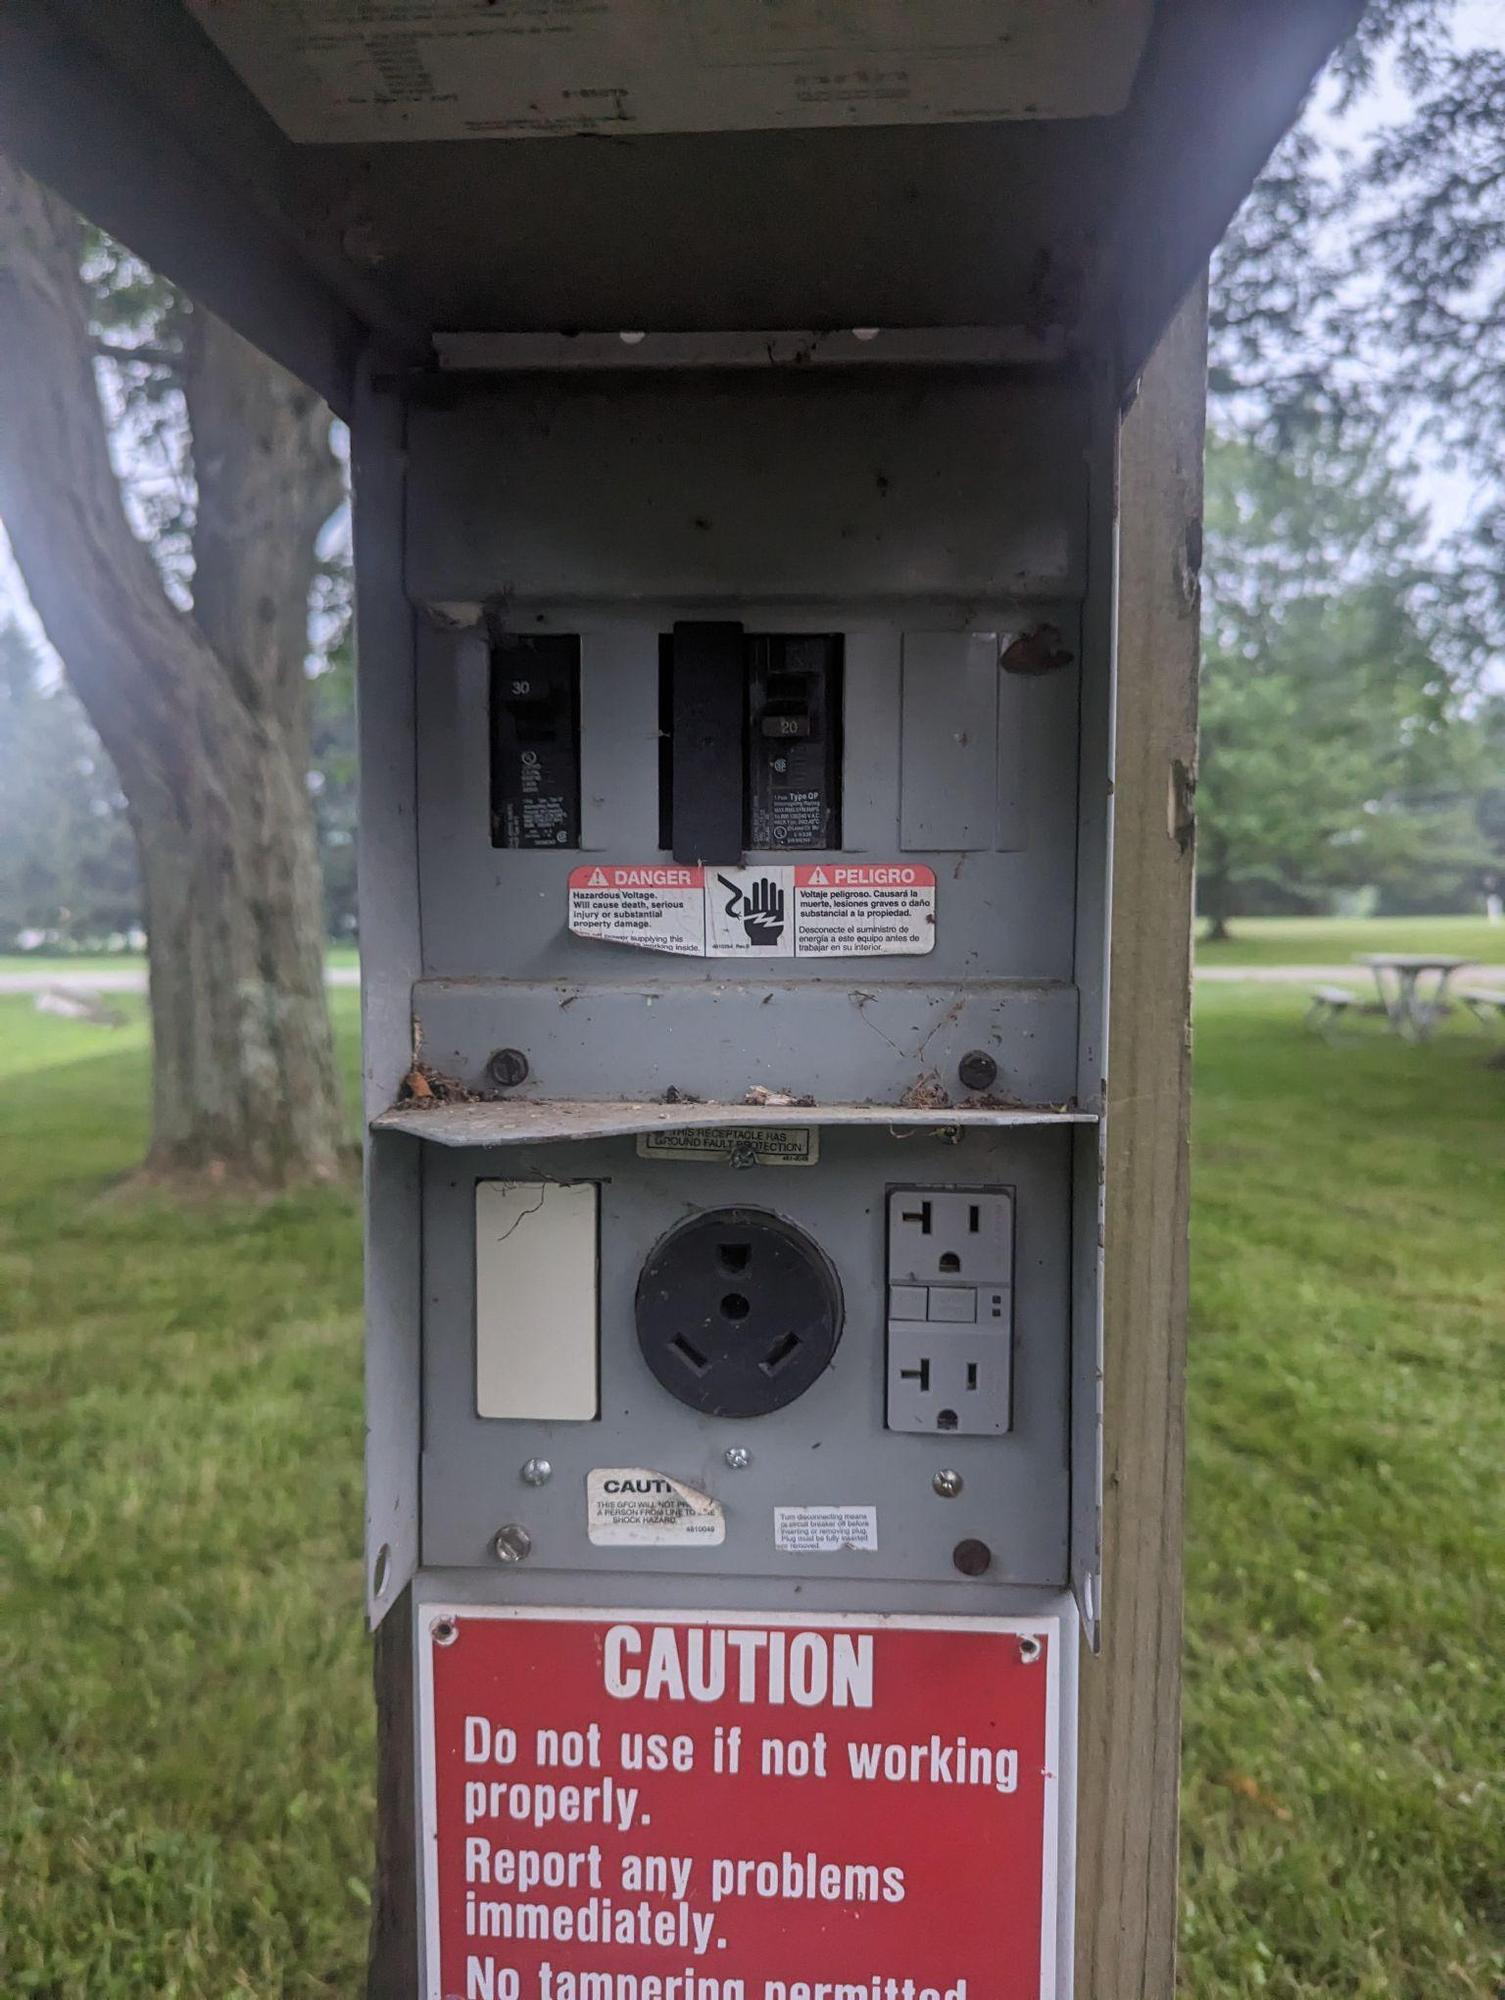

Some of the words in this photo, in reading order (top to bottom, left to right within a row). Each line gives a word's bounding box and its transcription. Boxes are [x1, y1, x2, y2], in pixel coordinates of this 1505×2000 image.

[511, 681, 530, 695] 30
[790, 792, 807, 801] Type
[614, 870, 692, 886] DANGER
[834, 868, 916, 884] PELIGRO
[573, 891, 620, 900] Hazardous
[622, 891, 658, 901] Voltage.
[800, 889, 828, 900] Voltaje
[830, 890, 872, 900] peligroso.
[873, 889, 908, 898] Causará
[910, 890, 918, 898] la
[573, 901, 590, 909] Will
[621, 901, 649, 910] death,
[651, 901, 684, 909] serious
[800, 901, 832, 909] muerte,
[833, 900, 869, 908] lesiones
[870, 901, 899, 910] graves
[908, 899, 931, 908] daño
[573, 910, 599, 920] injury
[601, 911, 611, 919] or
[613, 910, 663, 919] substantial
[800, 909, 848, 918] substancial
[857, 909, 865, 917] la
[867, 909, 912, 919] propiedad.
[573, 920, 611, 929] property
[614, 919, 652, 929] damage.
[799, 926, 846, 935] Desconecte
[847, 926, 855, 935] el
[856, 926, 897, 934] suministro
[898, 926, 909, 934] de
[630, 935, 668, 944] supplying
[670, 934, 684, 943] this
[799, 935, 828, 945] energía
[838, 935, 855, 943] este
[856, 935, 884, 944] equipo
[885, 935, 908, 943] antes
[909, 934, 920, 942] de
[675, 942, 699, 951] inside.
[799, 944, 829, 953] trabajar
[854, 943, 883, 951] interior.
[671, 1127, 695, 1138] THIS
[697, 1128, 764, 1141] RECEPTACLE
[765, 1131, 788, 1142] HAS
[703, 1138, 734, 1148] FAULT
[603, 1479, 672, 1494] CAUTI
[596, 1501, 616, 1509] THIS
[638, 1501, 656, 1509] WILL
[658, 1501, 675, 1509] NOT
[596, 1508, 603, 1516] A
[604, 1508, 639, 1516] PERSON
[640, 1508, 664, 1516] FROM
[665, 1509, 683, 1517] LINE
[685, 1508, 696, 1516] TO
[797, 1513, 843, 1521] disconnecting
[612, 1516, 641, 1525] SHOCK
[604, 1624, 874, 1708] CAUTION
[464, 1716, 517, 1764] Do
[536, 1723, 601, 1768] not
[620, 1733, 694, 1772] use
[714, 1726, 742, 1774] if
[761, 1732, 827, 1777] not
[847, 1735, 1019, 1794] working
[465, 1776, 651, 1832] properly.
[465, 1837, 602, 1893] Report
[621, 1855, 693, 1900] any
[712, 1851, 905, 1903] problems
[466, 1893, 727, 1955] immediately.
[466, 1955, 520, 2000] No
[538, 1962, 745, 2000] tampering
